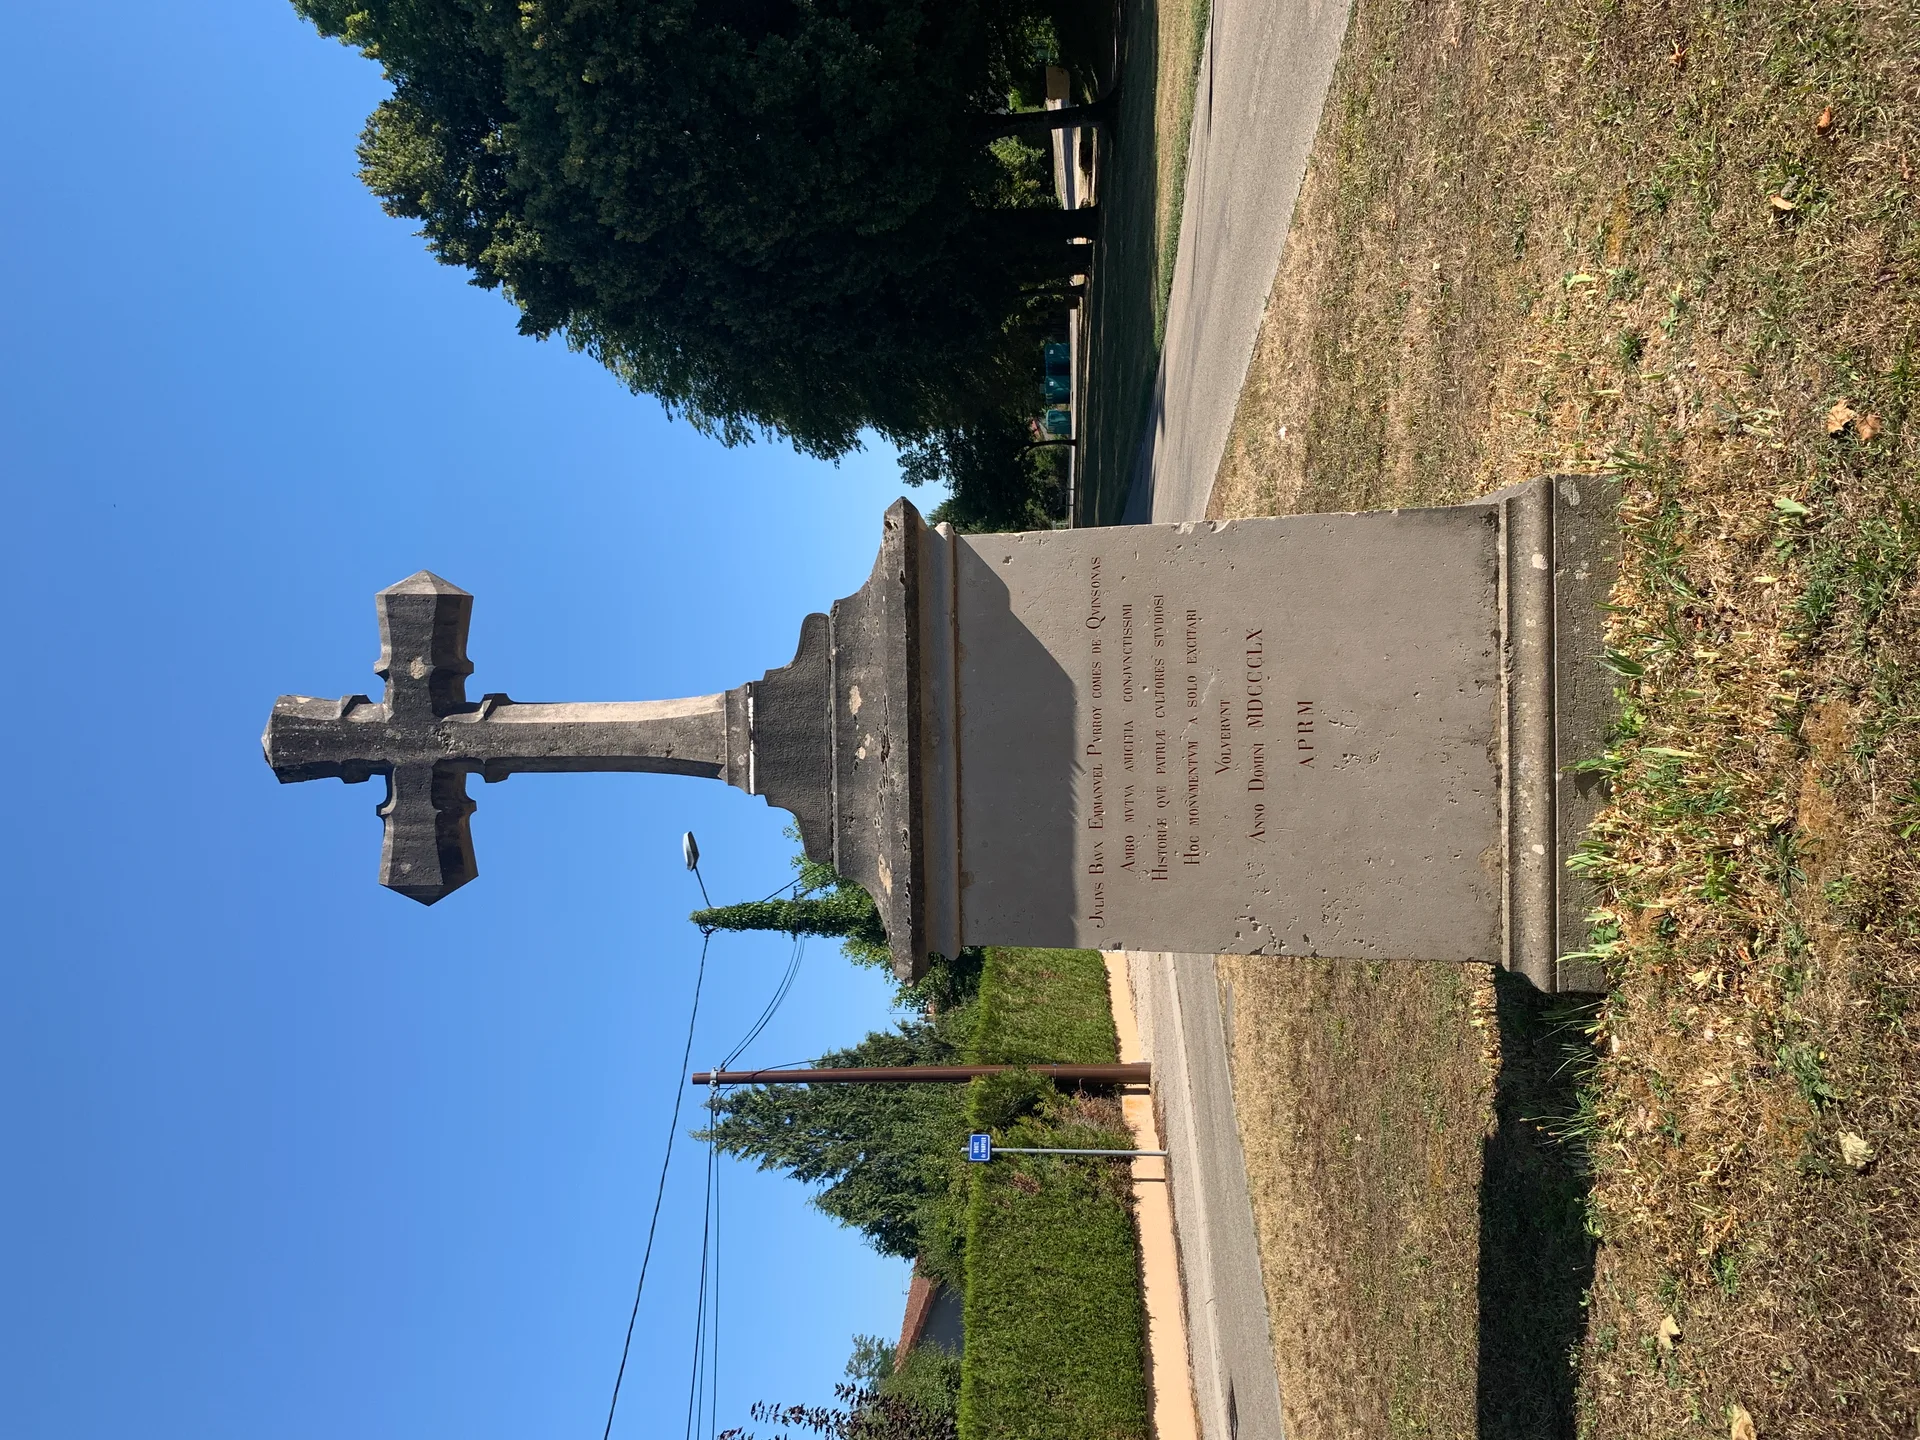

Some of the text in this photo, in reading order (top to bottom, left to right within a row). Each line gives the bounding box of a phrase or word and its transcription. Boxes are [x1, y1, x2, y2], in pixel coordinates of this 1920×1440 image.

[1085, 557, 1105, 629] QVINSONAS
[1092, 640, 1102, 653] DE
[1186, 609, 1197, 664] EXCITARI
[1092, 661, 1102, 699] COMES
[1187, 675, 1197, 708] SOLO
[1123, 720, 1134, 772] AMICITIA
[1246, 628, 1266, 843] ANNO DOMINI MDCCCLX
[1088, 764, 1104, 830] EMMANVEL
[1120, 835, 1135, 873] AMBO
[1183, 836, 1200, 866] HOC
